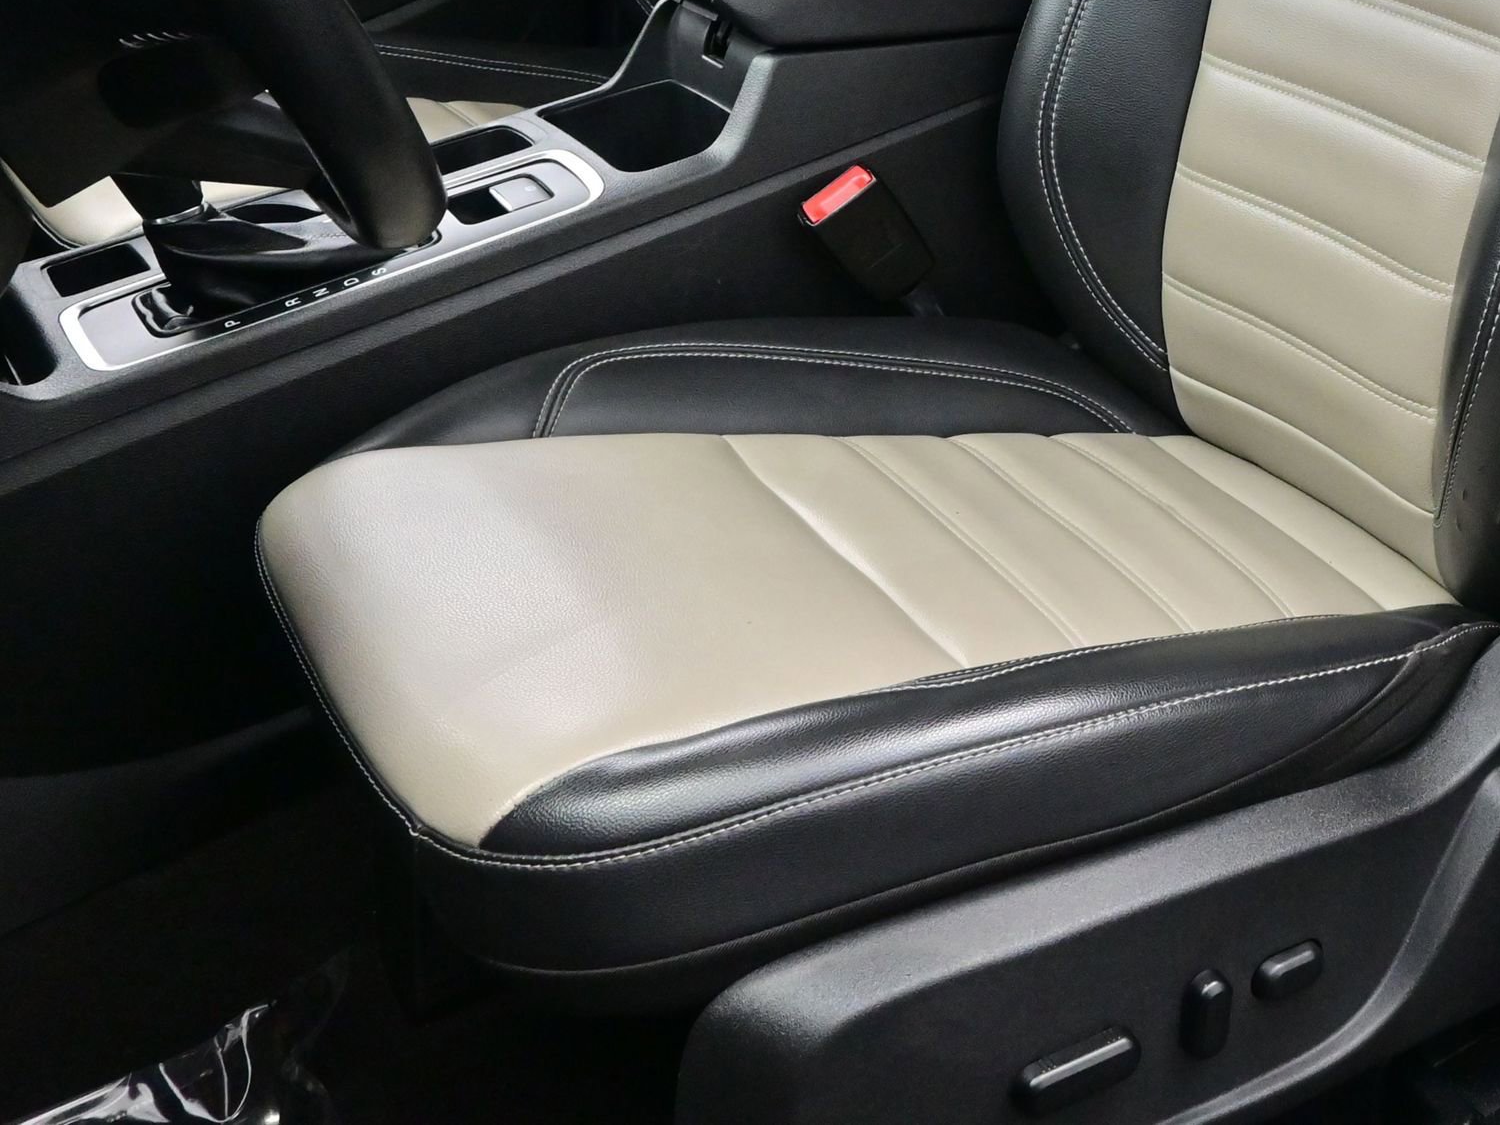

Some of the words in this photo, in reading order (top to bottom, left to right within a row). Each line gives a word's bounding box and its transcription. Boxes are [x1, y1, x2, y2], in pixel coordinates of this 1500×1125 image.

[224, 320, 241, 329] P
[285, 297, 302, 307] R
[313, 287, 330, 298] N
[343, 277, 359, 287] D
[371, 267, 387, 276] S
